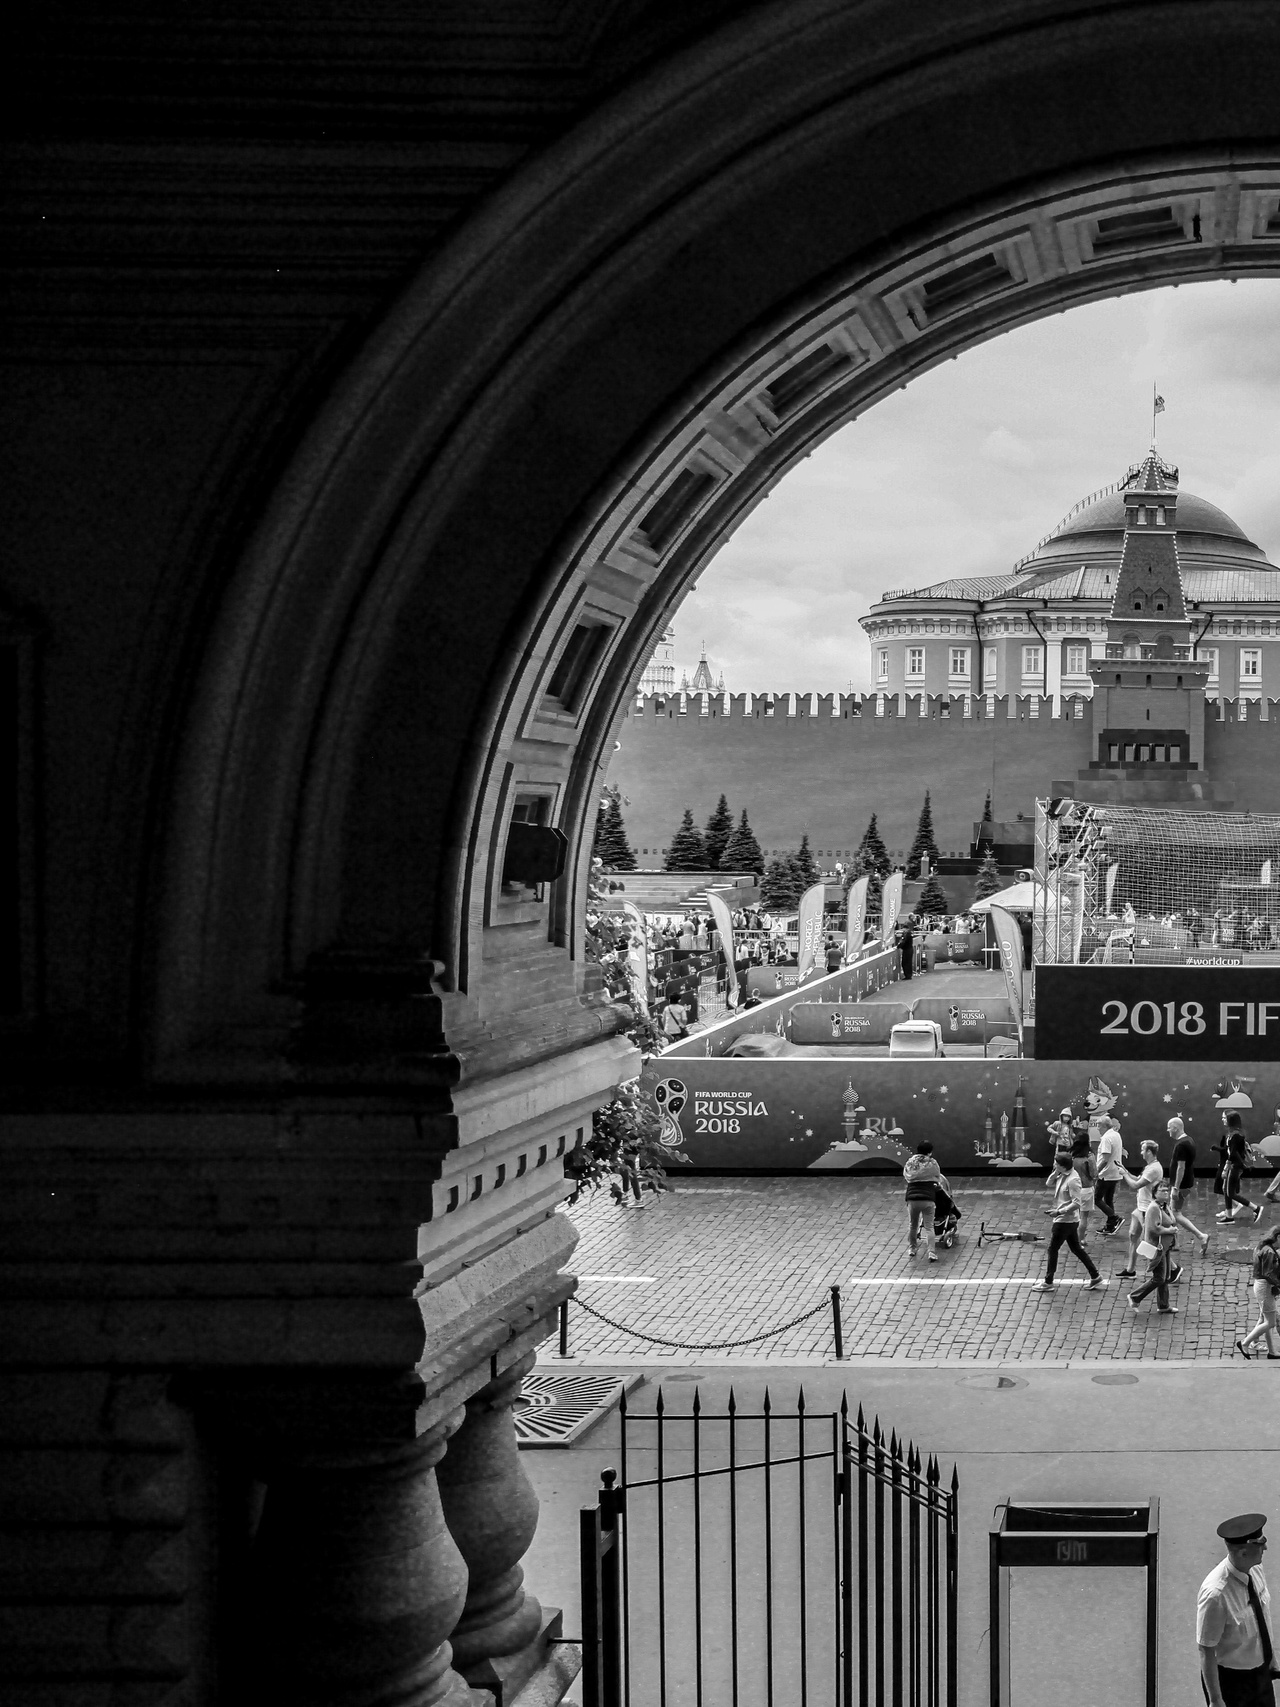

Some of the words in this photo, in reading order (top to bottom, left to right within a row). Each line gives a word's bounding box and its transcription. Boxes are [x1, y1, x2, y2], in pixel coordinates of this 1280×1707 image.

[804, 917, 814, 952] KOREA
[1100, 1000, 1207, 1036] 2018
[694, 1100, 769, 1117] RUSSIA
[694, 1118, 742, 1134] 2018
[865, 1117, 897, 1134] RU
